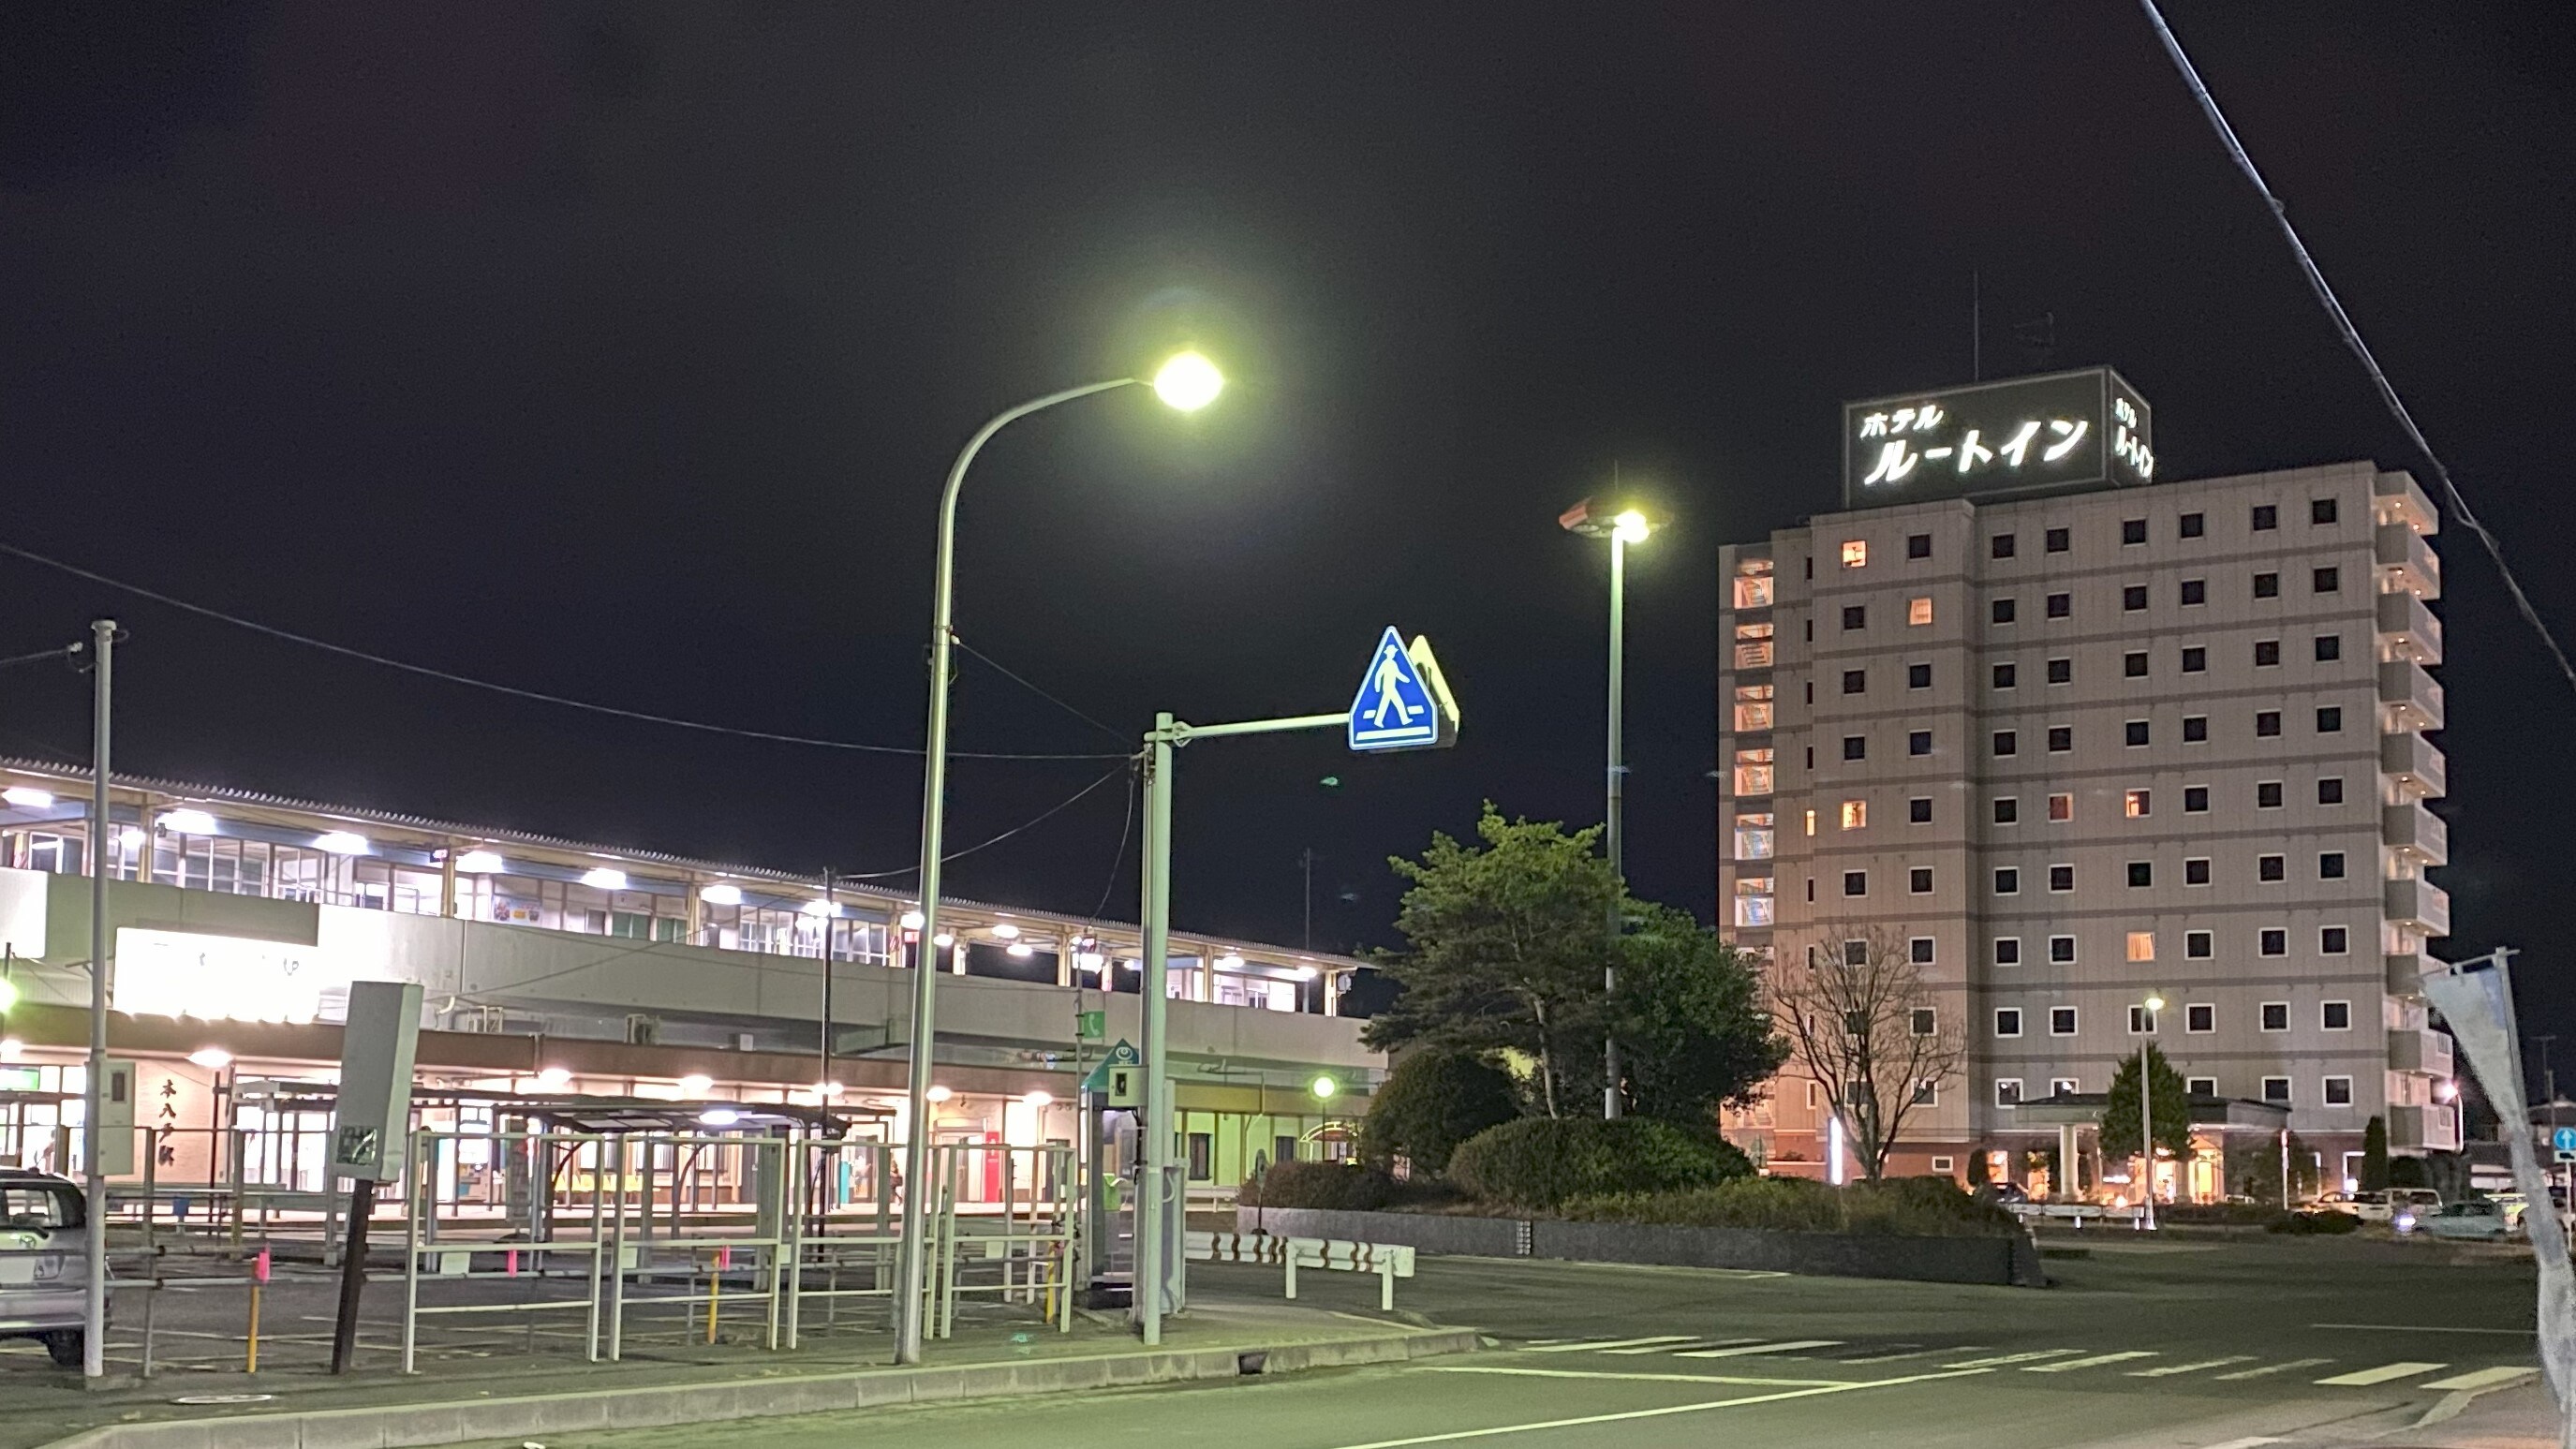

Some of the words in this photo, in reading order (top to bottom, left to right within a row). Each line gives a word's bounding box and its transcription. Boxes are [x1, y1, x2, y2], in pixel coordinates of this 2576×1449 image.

[1859, 405, 1944, 438] ホテル
[1864, 420, 2089, 485] ルートイン
[2115, 424, 2154, 478] ルートイン
